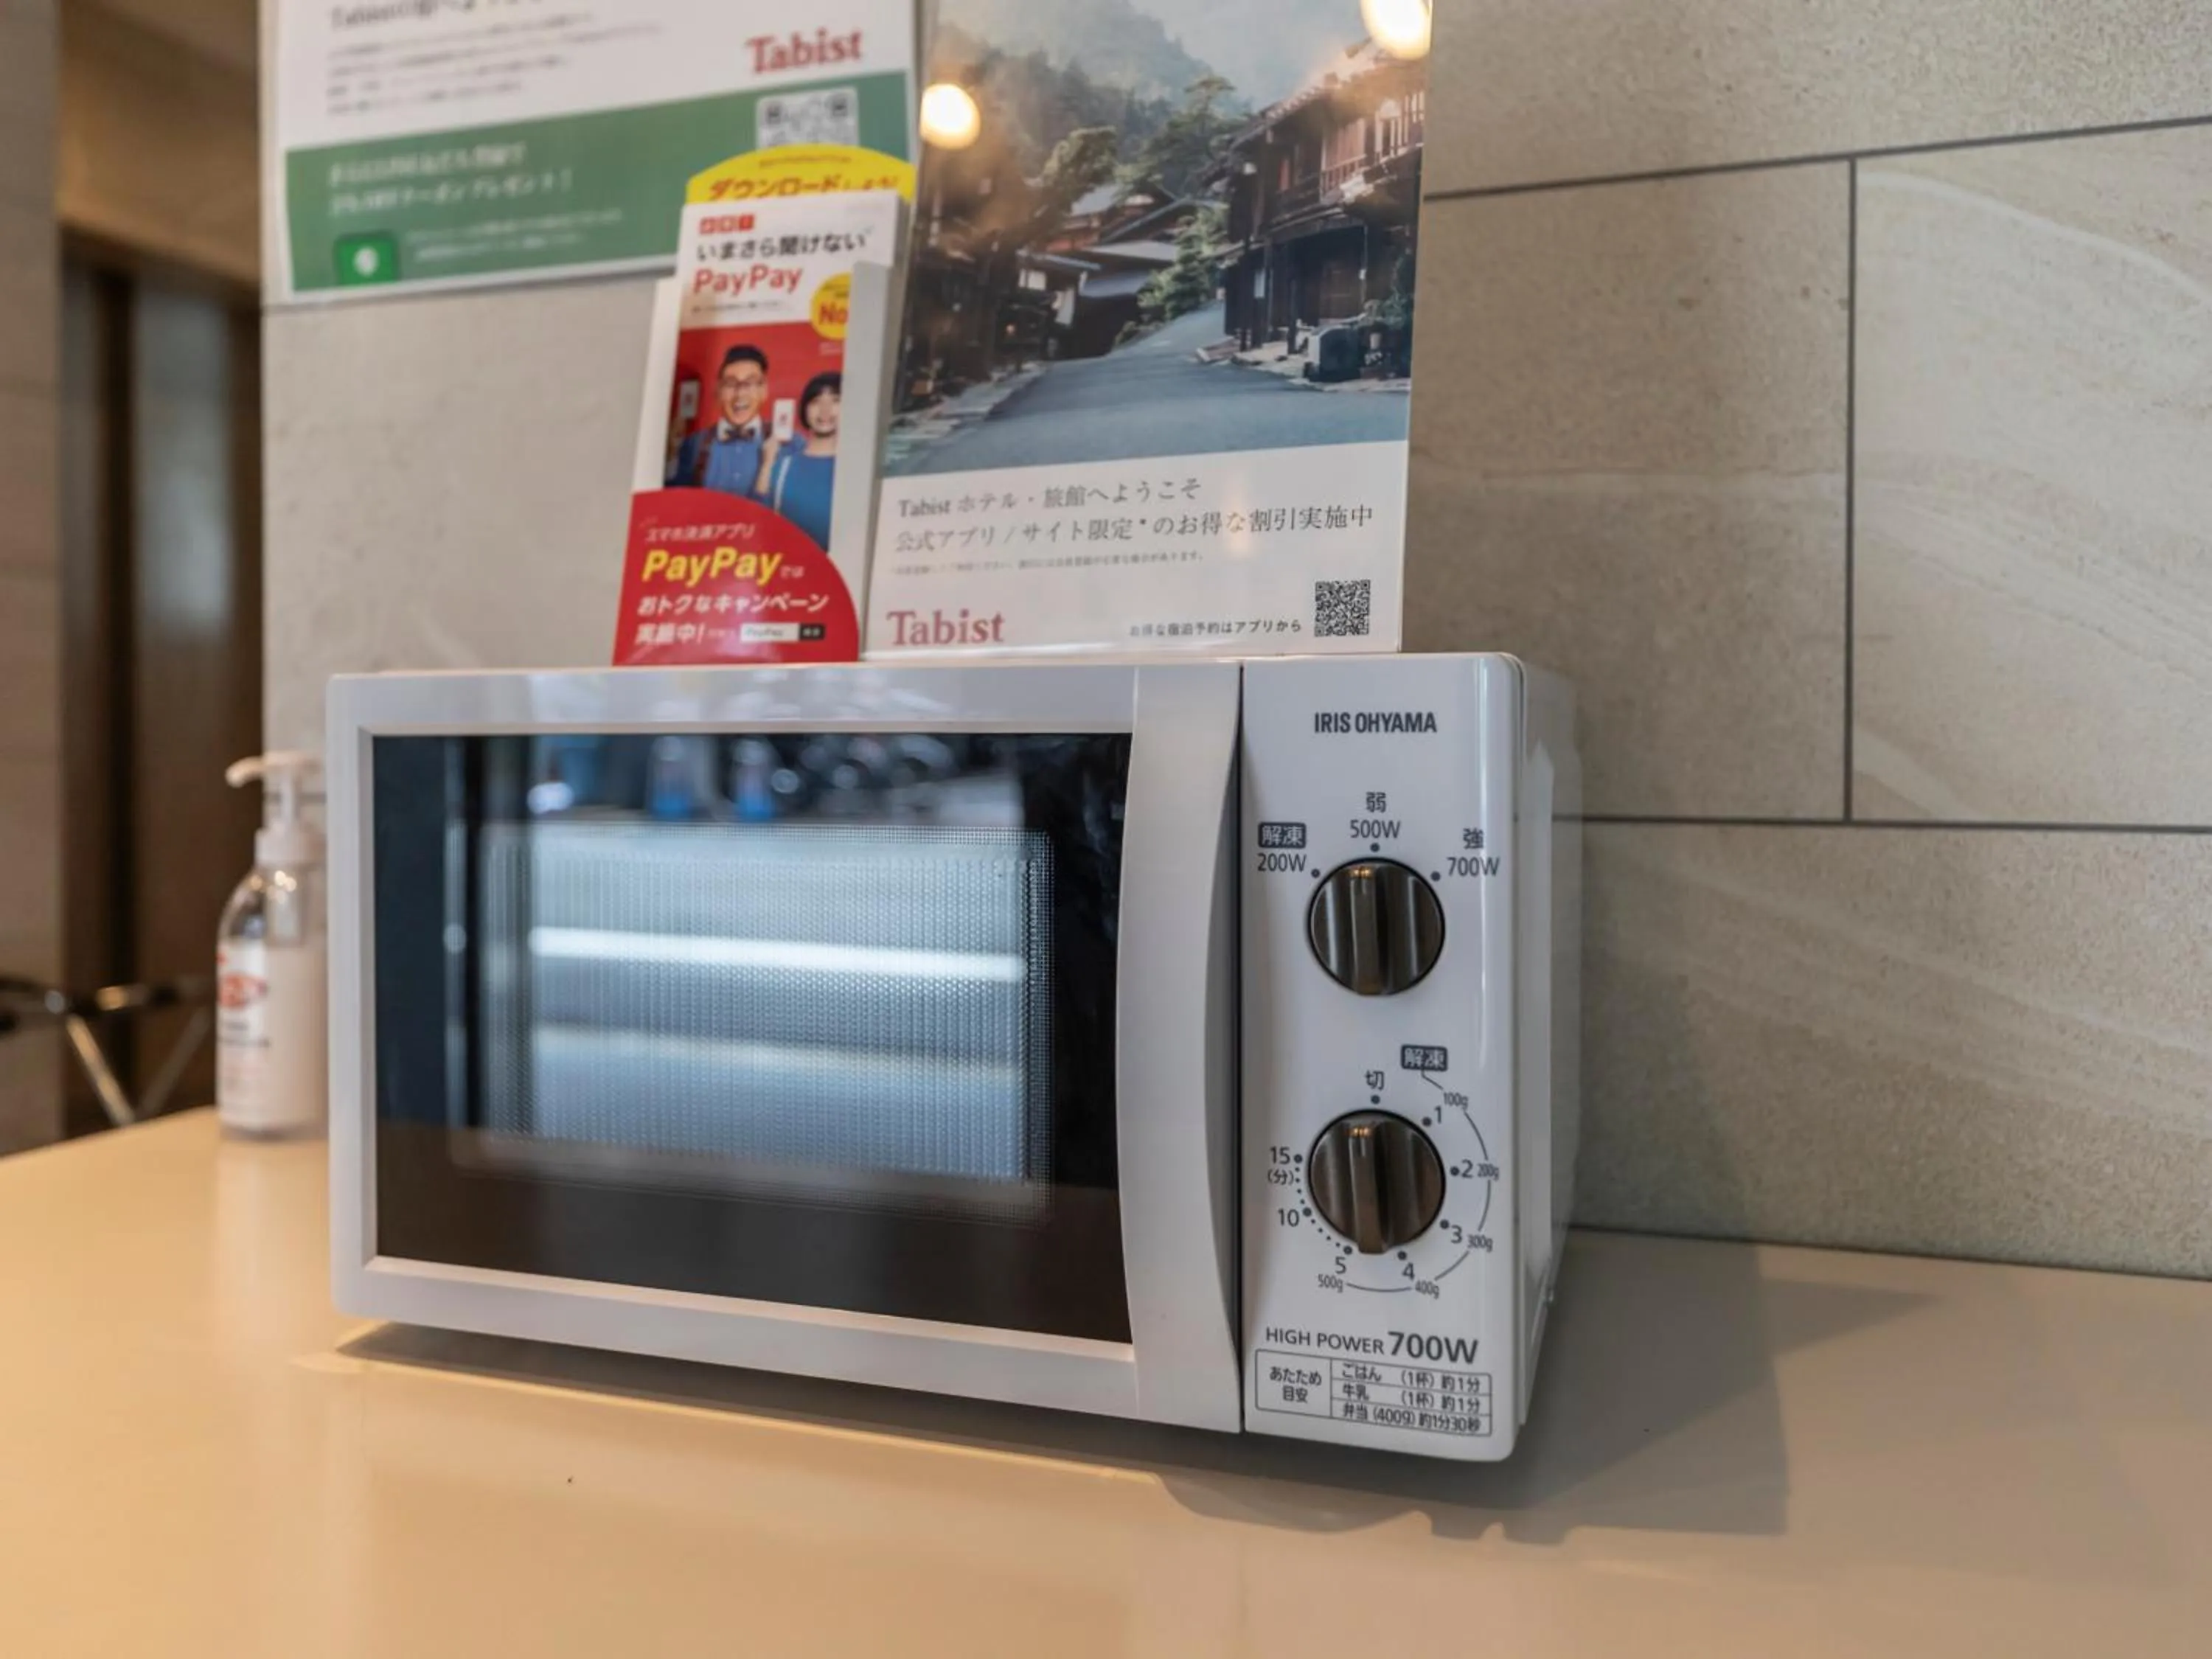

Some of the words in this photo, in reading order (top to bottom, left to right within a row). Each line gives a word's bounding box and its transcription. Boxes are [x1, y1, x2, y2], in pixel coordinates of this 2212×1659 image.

[743, 27, 862, 74] Tabist
[697, 233, 866, 261] いまさら聞けない
[692, 263, 802, 294] PayPay
[898, 497, 951, 518] Tabist
[641, 546, 782, 588] PayPay
[637, 592, 830, 617] おトクなキャンペーン
[886, 609, 1005, 646] Tabist
[1314, 712, 1351, 734] IRIS
[1354, 712, 1437, 734] OHYAMA
[1366, 791, 1386, 813] 弱
[1262, 825, 1304, 846] 解凍
[1349, 820, 1400, 839] 500W
[1463, 827, 1484, 849] 強
[1257, 853, 1307, 873] 200W
[1447, 857, 1500, 877] 700W
[1403, 1048, 1446, 1069] 解凍
[1366, 1071, 1385, 1090] 切
[1443, 1091, 1469, 1109] 100g
[1434, 1107, 1442, 1124] 1
[1270, 1147, 1290, 1164] 15
[1461, 1160, 1473, 1178] 2
[1477, 1164, 1500, 1180] 200g
[1278, 1209, 1300, 1227] 10
[1451, 1225, 1463, 1244] 3
[1467, 1235, 1493, 1252] 300g
[1335, 1257, 1347, 1274] 5
[1402, 1263, 1415, 1280] 4
[1317, 1273, 1344, 1293] 500g
[1415, 1280, 1440, 1299] 400g
[1265, 1326, 1311, 1346] HIGH
[1316, 1332, 1385, 1355] POWER
[1388, 1331, 1478, 1364] 700W
[1269, 1366, 1322, 1387] あたため
[1342, 1363, 1382, 1382] ごはん
[1441, 1374, 1481, 1393] 約1分
[1281, 1385, 1308, 1403] 目安
[1342, 1382, 1370, 1402] 牛乳
[1441, 1394, 1481, 1413] 約1分
[1342, 1403, 1368, 1421] 弁当
